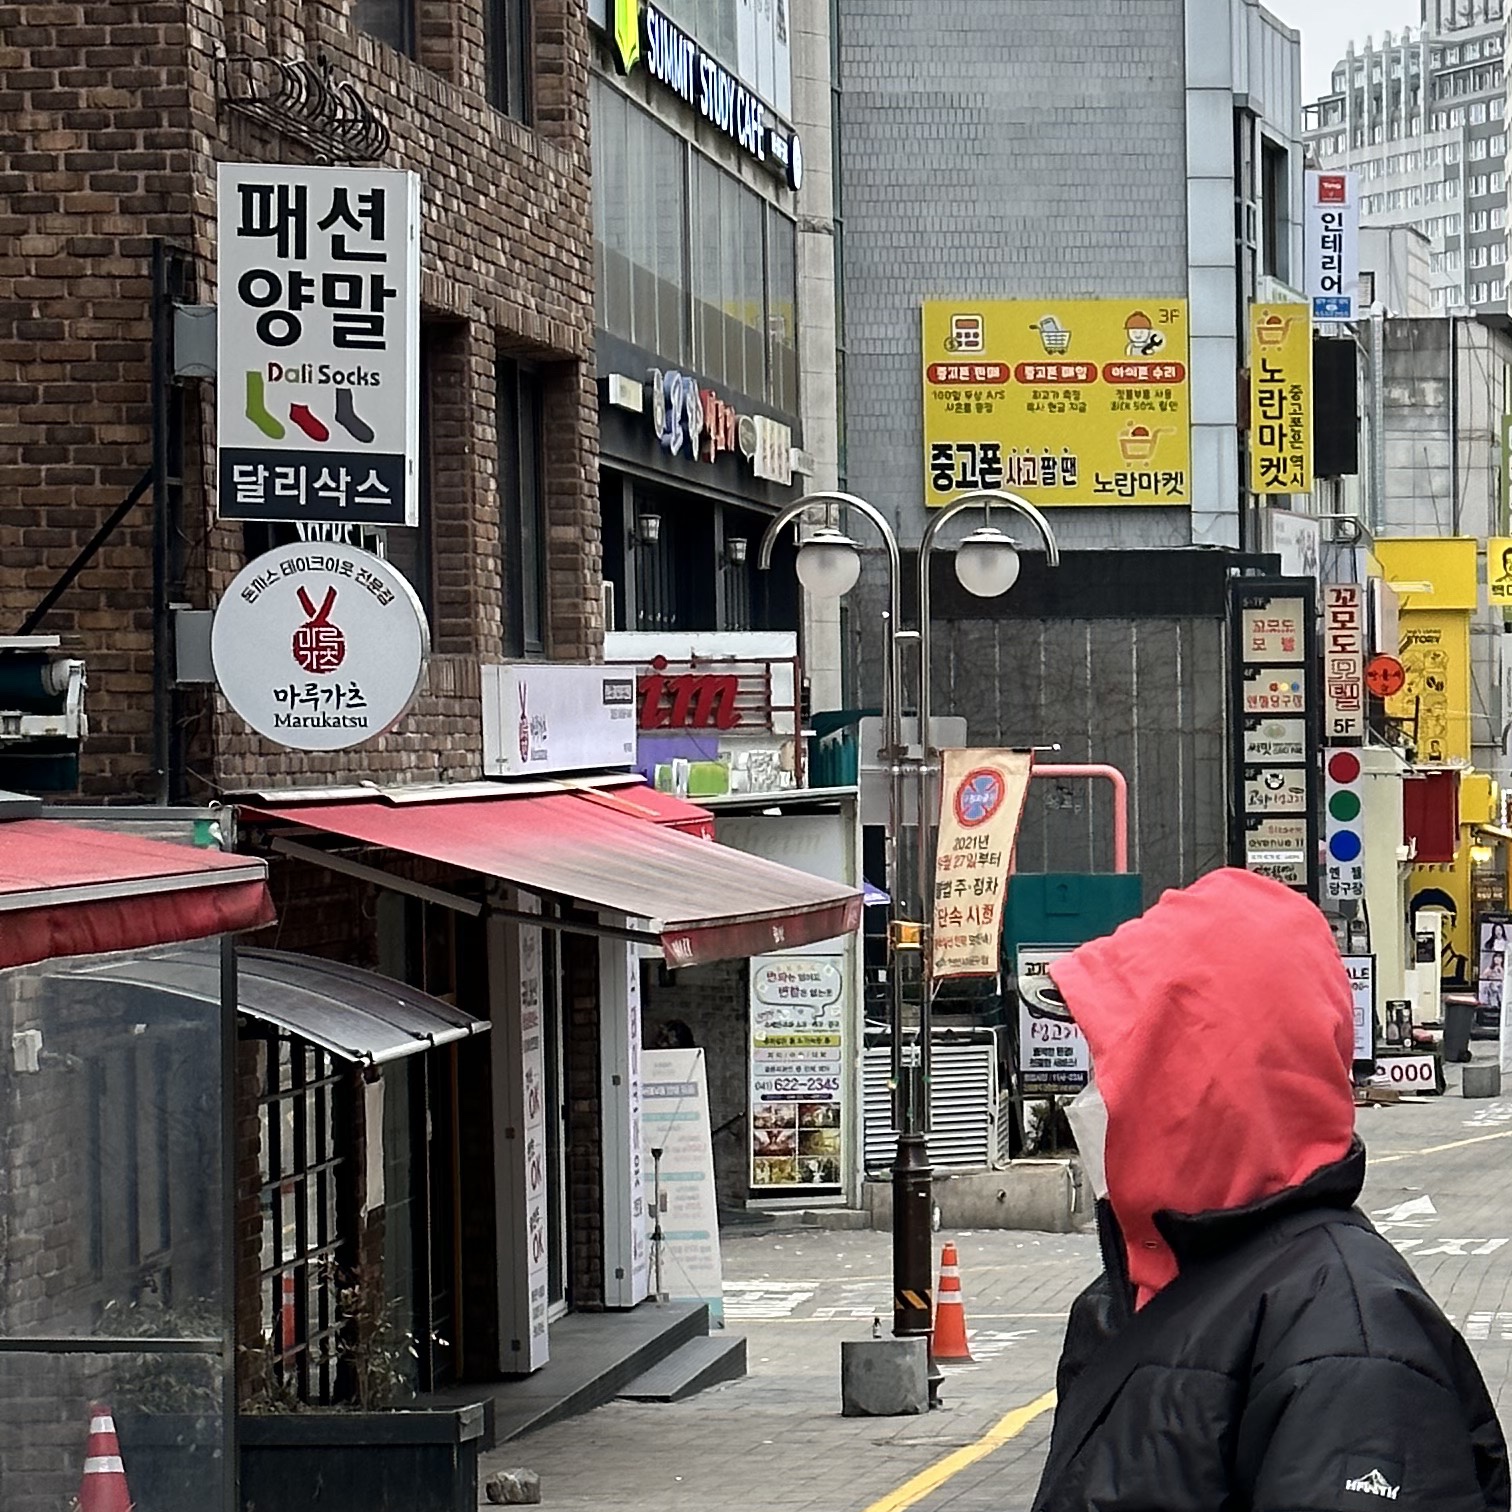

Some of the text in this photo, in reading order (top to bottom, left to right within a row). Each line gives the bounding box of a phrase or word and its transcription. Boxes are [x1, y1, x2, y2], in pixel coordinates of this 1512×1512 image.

[647, 7, 695, 105] SUMMIT
[700, 53, 735, 138] STUDY
[237, 182, 387, 263] 패션
[1321, 212, 1343, 294] 인테리어
[238, 268, 397, 350] 양말
[1159, 309, 1180, 324] 3F
[267, 361, 381, 388] Dali Socks
[1258, 358, 1288, 487] 노란마켓
[232, 463, 392, 506] 달리삭스
[931, 443, 1003, 491] 중고폰
[1093, 472, 1184, 497] 노란마켓
[240, 569, 281, 604] 돈까스
[355, 567, 396, 607] 전문점
[273, 681, 368, 712] 마루가츠
[274, 711, 369, 728] Marukatsu
[1334, 719, 1355, 733] 5F
[954, 835, 990, 850] 2021년
[1329, 883, 1363, 896] 당구장
